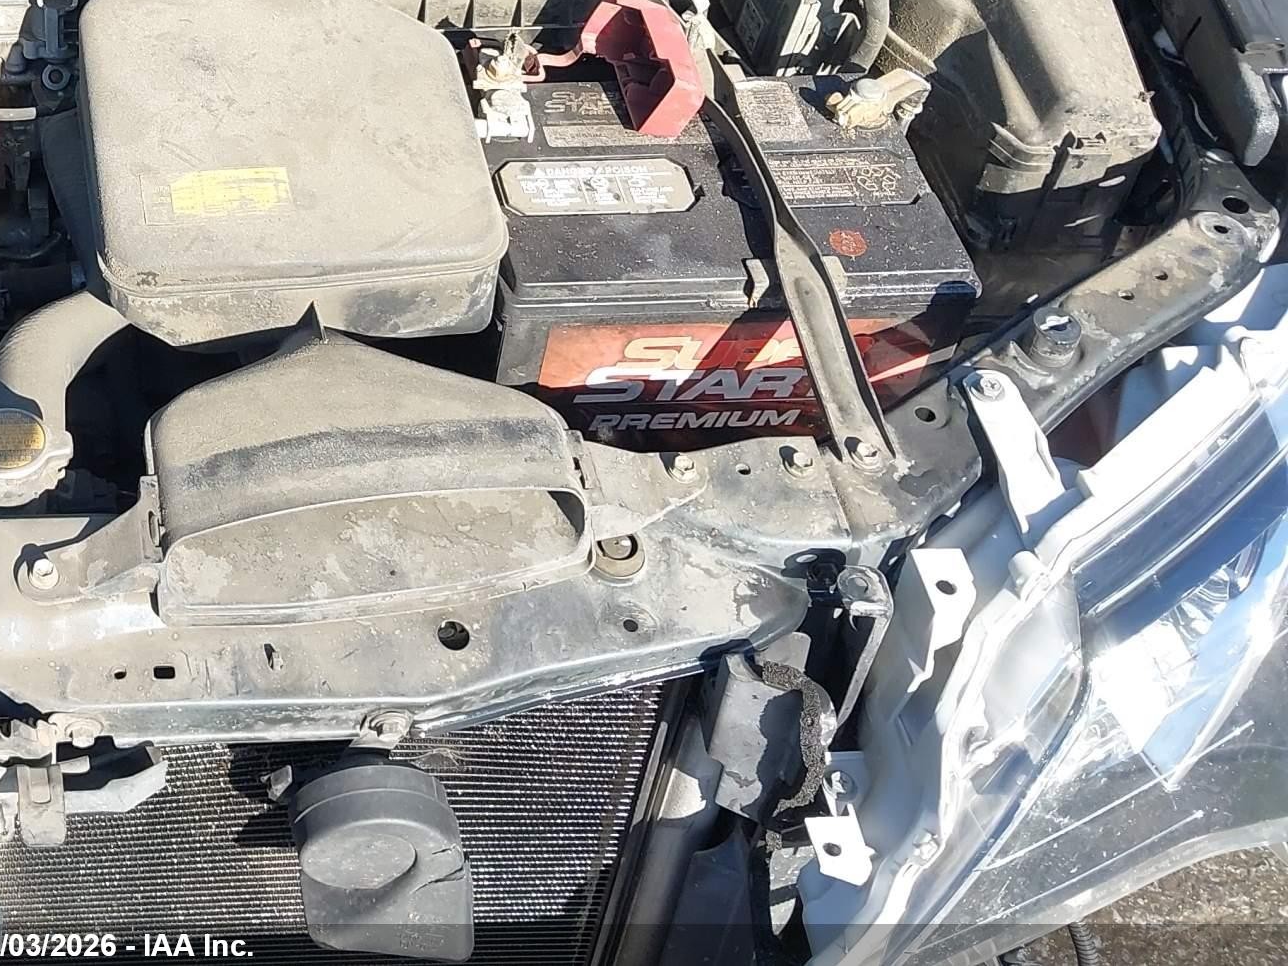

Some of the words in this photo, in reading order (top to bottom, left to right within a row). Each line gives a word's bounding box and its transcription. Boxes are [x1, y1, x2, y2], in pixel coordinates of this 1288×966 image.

[605, 165, 648, 176] POISON
[573, 366, 814, 403] STAR
[588, 409, 801, 432] PREMIUM
